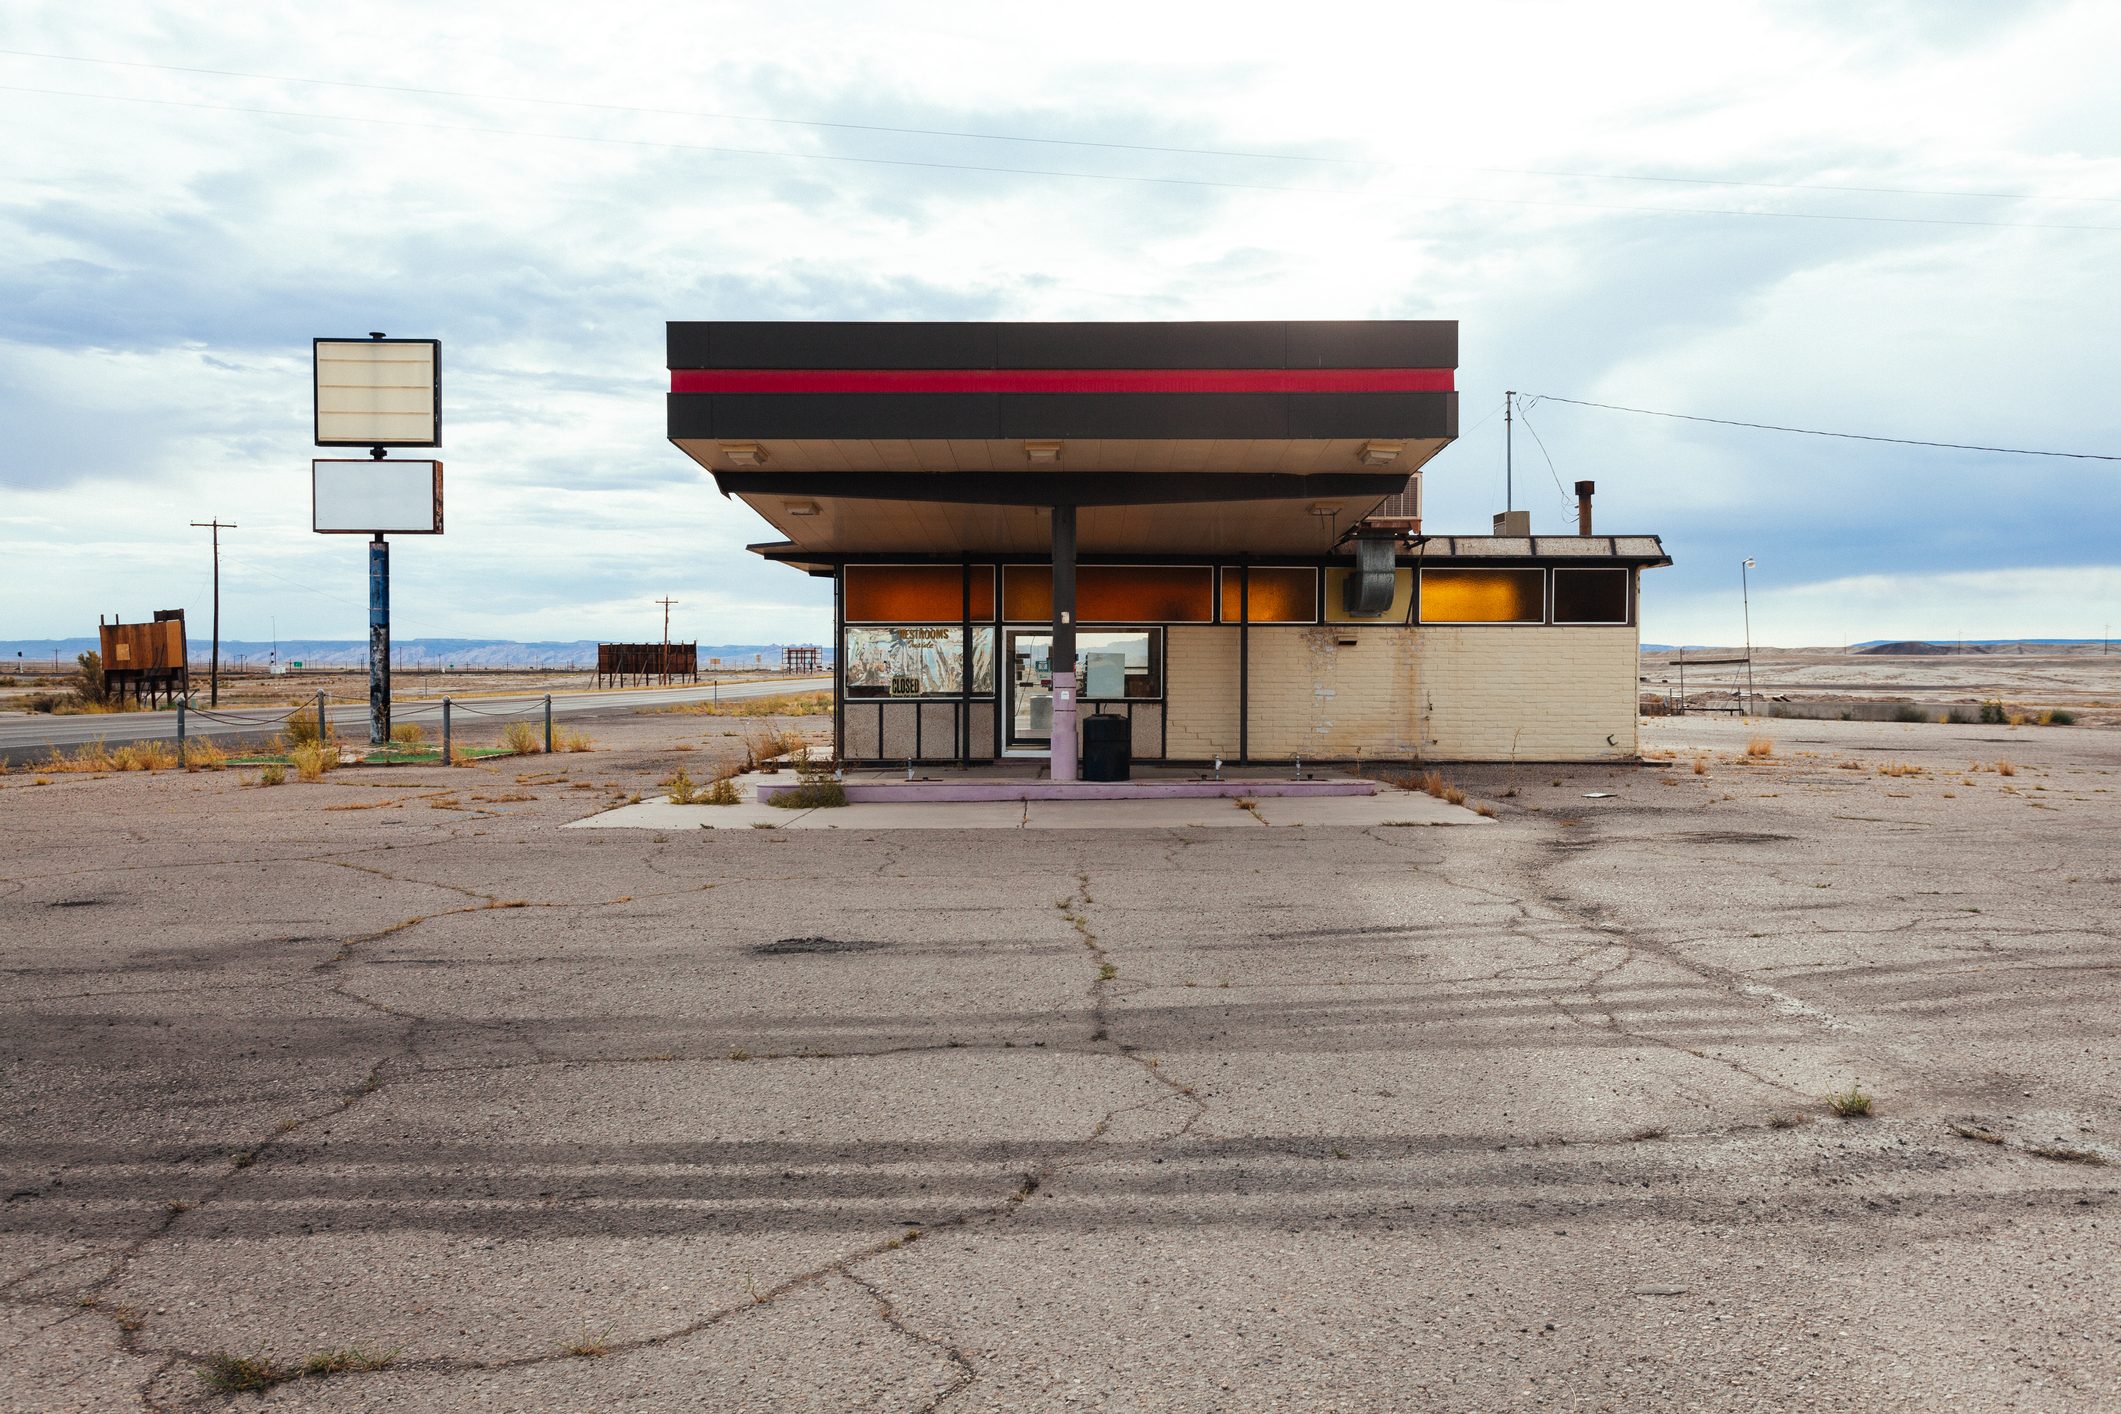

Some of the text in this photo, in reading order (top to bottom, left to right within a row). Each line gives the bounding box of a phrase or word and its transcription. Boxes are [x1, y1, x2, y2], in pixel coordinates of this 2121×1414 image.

[899, 629, 949, 639] RESTROOMS
[907, 640, 934, 649] Inside
[892, 679, 920, 693] CLOSED
